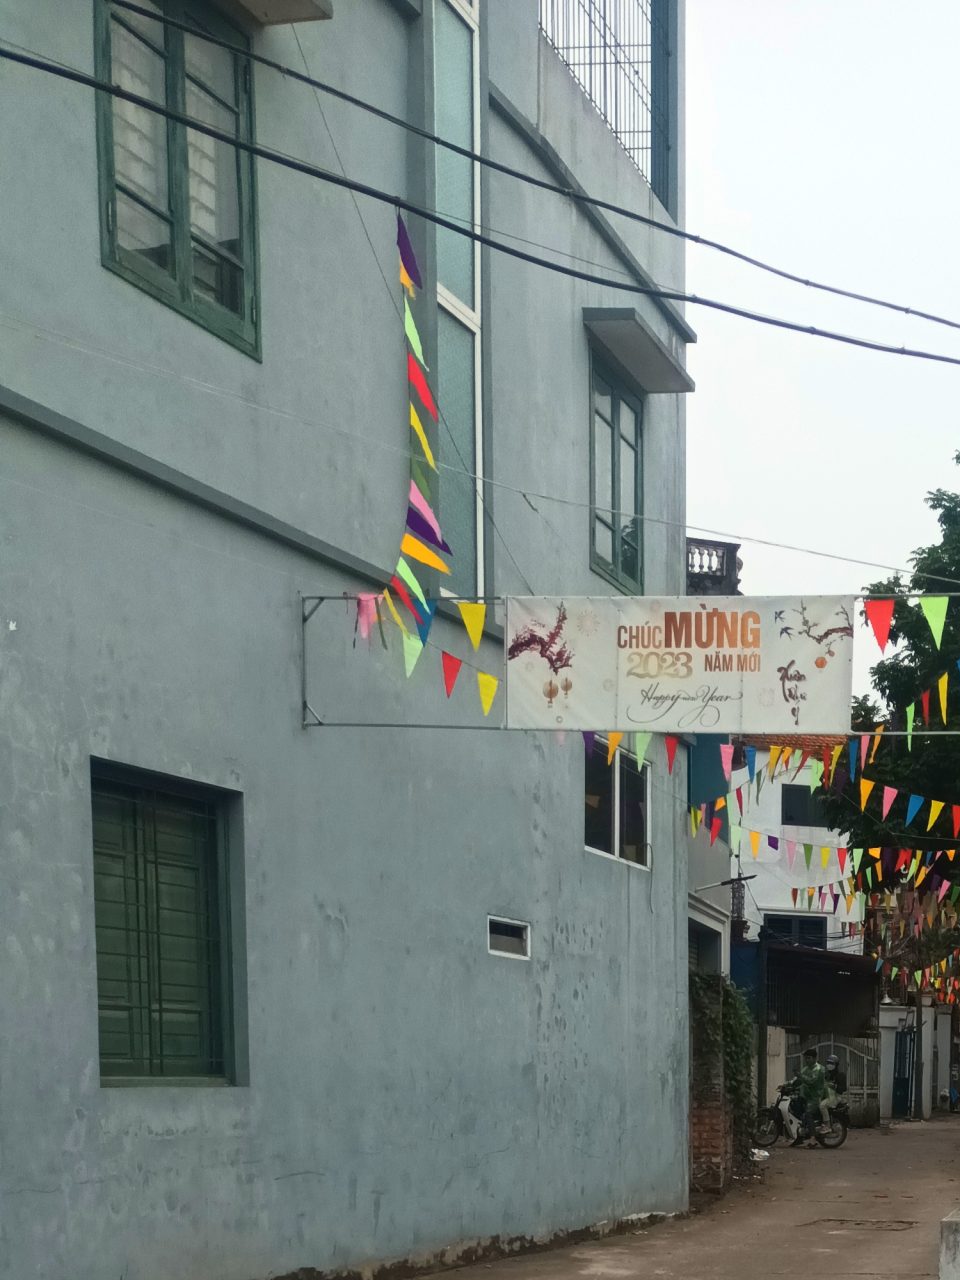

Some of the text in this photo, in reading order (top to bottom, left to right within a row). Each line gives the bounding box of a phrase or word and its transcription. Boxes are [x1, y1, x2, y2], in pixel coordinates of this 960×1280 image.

[617, 603, 761, 649] CHÚC MỪNG
[626, 651, 693, 679] 2023
[704, 651, 761, 672] NĂM MỚI
